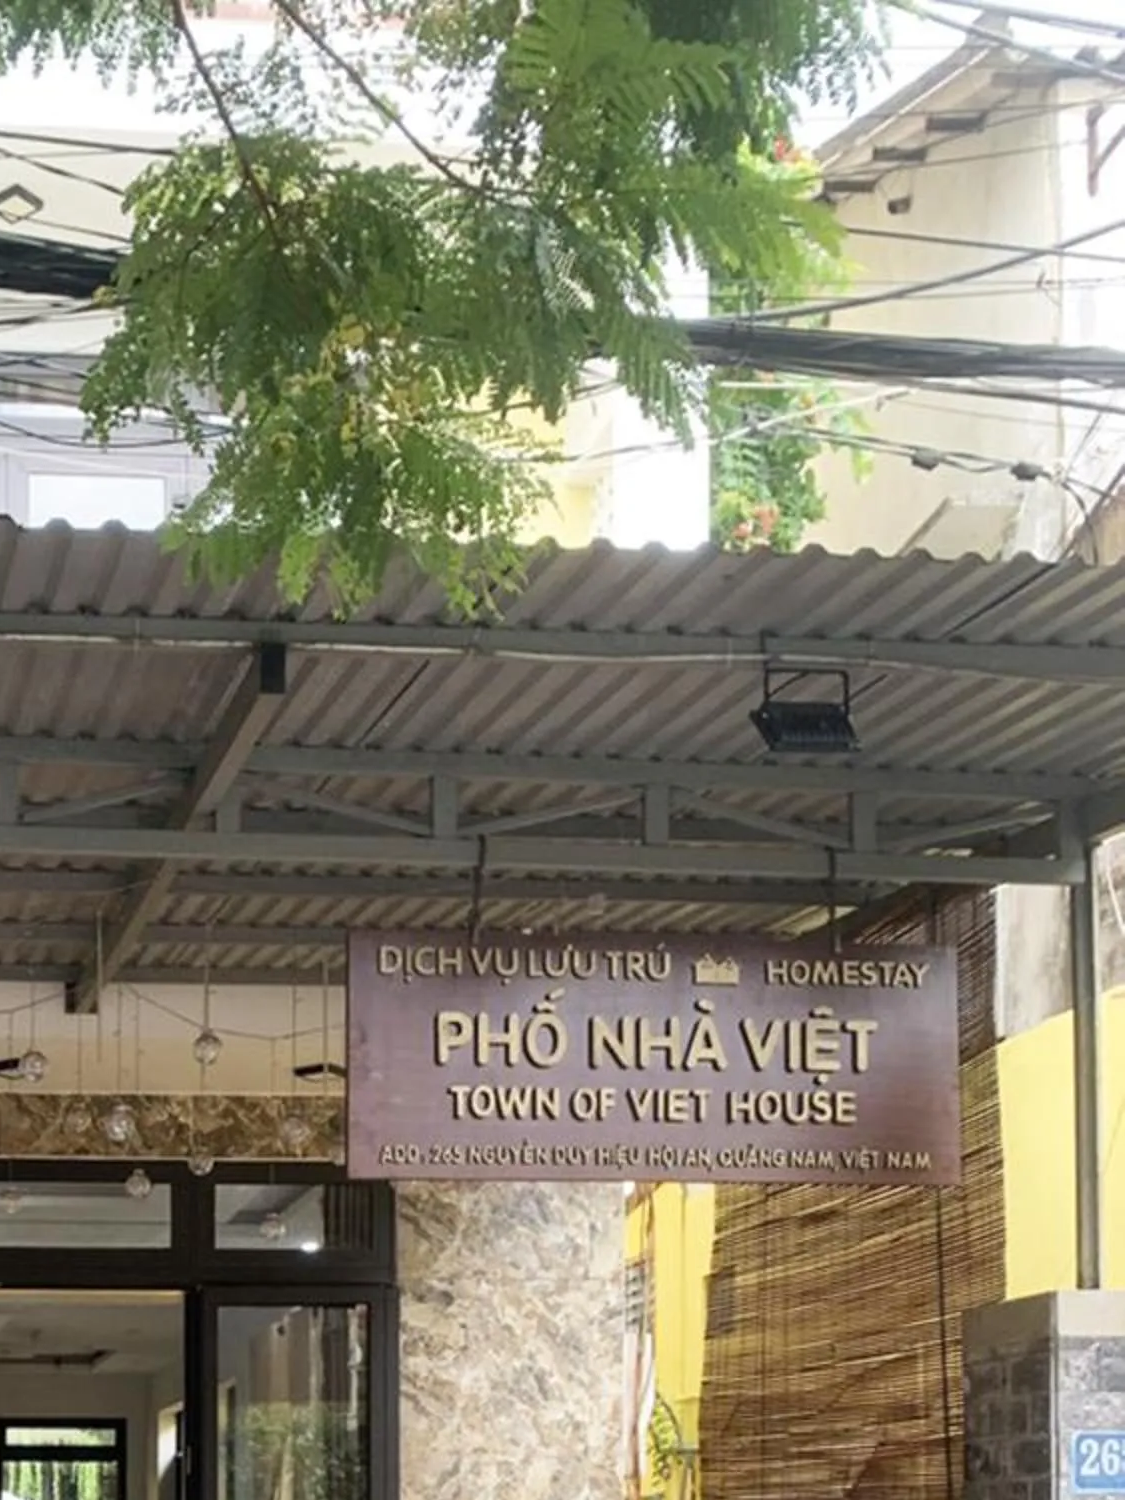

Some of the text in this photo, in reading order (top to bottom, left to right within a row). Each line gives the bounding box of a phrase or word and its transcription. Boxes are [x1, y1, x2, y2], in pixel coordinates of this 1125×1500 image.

[379, 942, 671, 985] DỊCH VỤ LƯU TRÚ
[766, 959, 930, 988] HOMESTAY
[434, 988, 878, 1085] PHỐ NHÀ VIỆT
[448, 1085, 857, 1124] TOWN OF VIET HOUSE
[429, 1145, 461, 1164] 265
[553, 1145, 589, 1166] DUY
[595, 1144, 639, 1170] HIỆU
[717, 1144, 787, 1169] QUẢNG
[840, 1147, 878, 1175] VIỆT
[883, 1151, 932, 1169] NAM
[1079, 1438, 1125, 1476] 26
